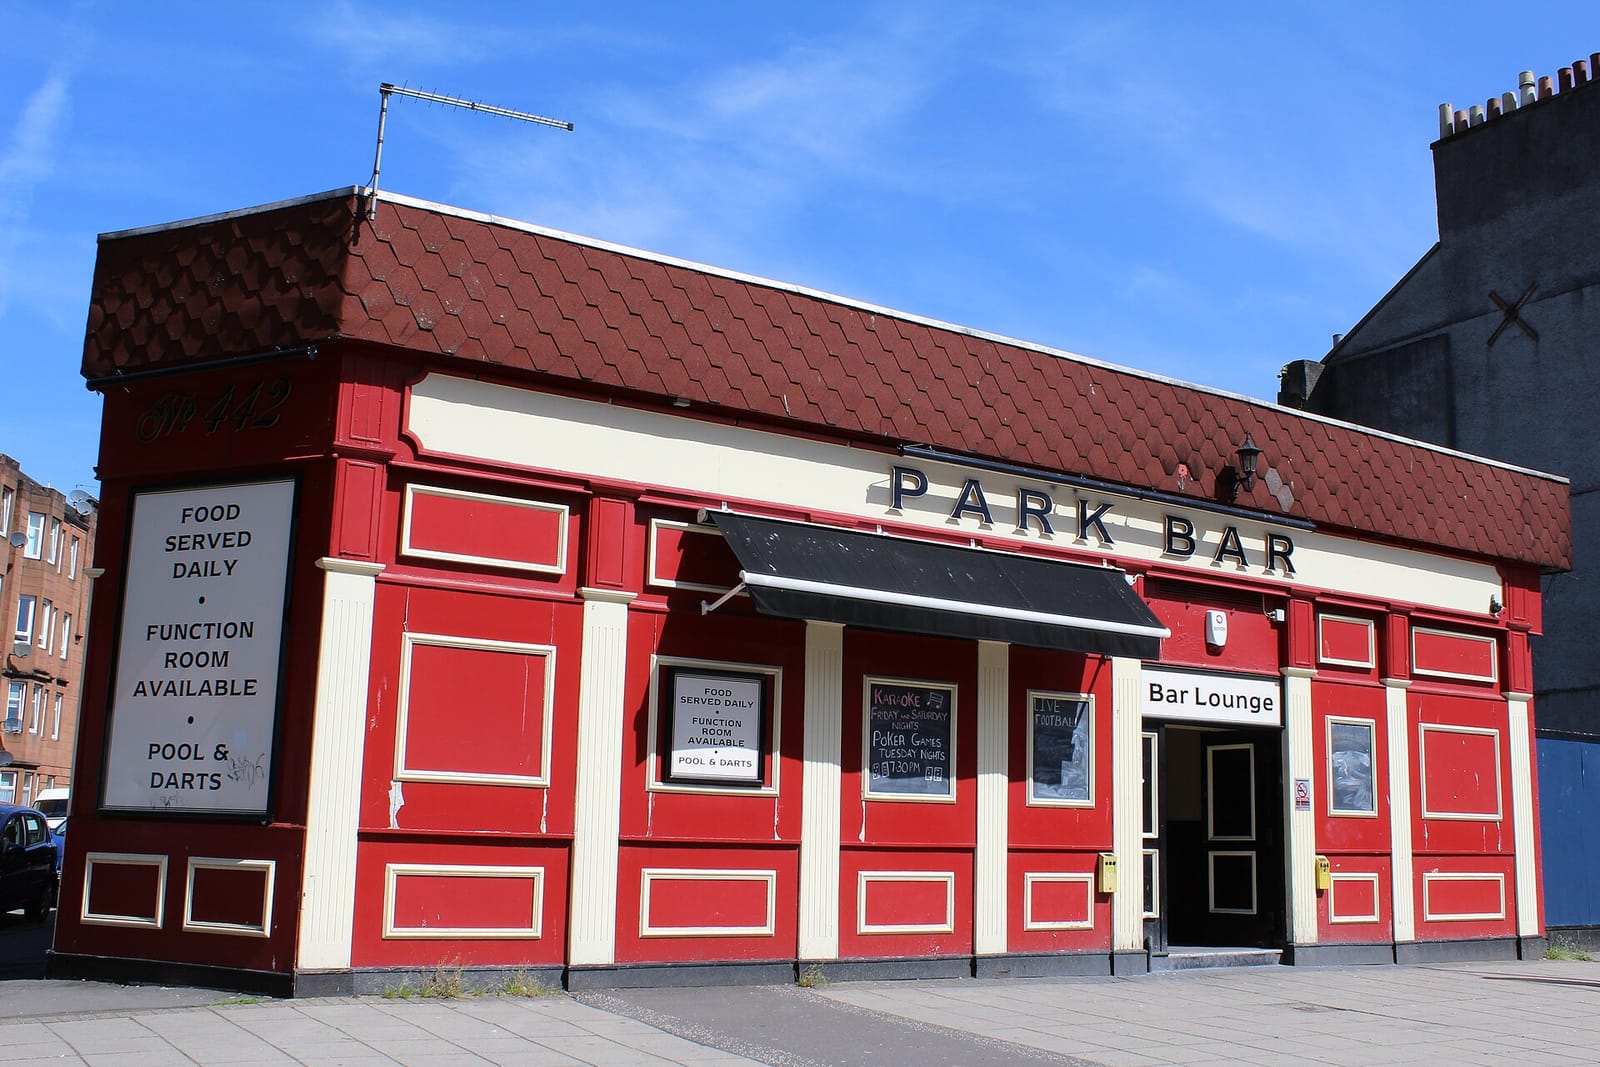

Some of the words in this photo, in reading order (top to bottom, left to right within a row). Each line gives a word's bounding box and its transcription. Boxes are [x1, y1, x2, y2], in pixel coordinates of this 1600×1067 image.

[204, 376, 292, 437] 442
[181, 504, 241, 524] FOOD
[890, 466, 1115, 544] PARK
[1162, 514, 1296, 574] BAR
[165, 531, 251, 552] SERVED
[173, 559, 238, 579] DAILY
[146, 621, 254, 641] FUNCTION
[164, 651, 229, 668] ROOM
[133, 679, 258, 697] AVAILABLE
[704, 688, 732, 696] FOOD
[680, 696, 721, 706] SERVED
[725, 700, 754, 708] DAILY
[874, 688, 920, 707] KARAOKE
[1034, 699, 1060, 712] LIVE
[1149, 683, 1188, 704] Bar
[1195, 687, 1273, 713] Lounge
[692, 718, 742, 727] FUNCTION
[892, 721, 919, 730] NIGHTS
[702, 728, 732, 736] ROOM
[873, 730, 905, 747] POKER
[912, 733, 941, 747] GAMES
[688, 737, 744, 747] AVAILABLE
[149, 744, 204, 760] POOL
[214, 744, 229, 761] &
[879, 749, 917, 758] TUESDAY
[920, 750, 945, 760] NIGHTS
[679, 757, 705, 766] POOL
[709, 758, 716, 766] &
[720, 759, 752, 767] DARTS
[150, 772, 221, 790] DARTS
